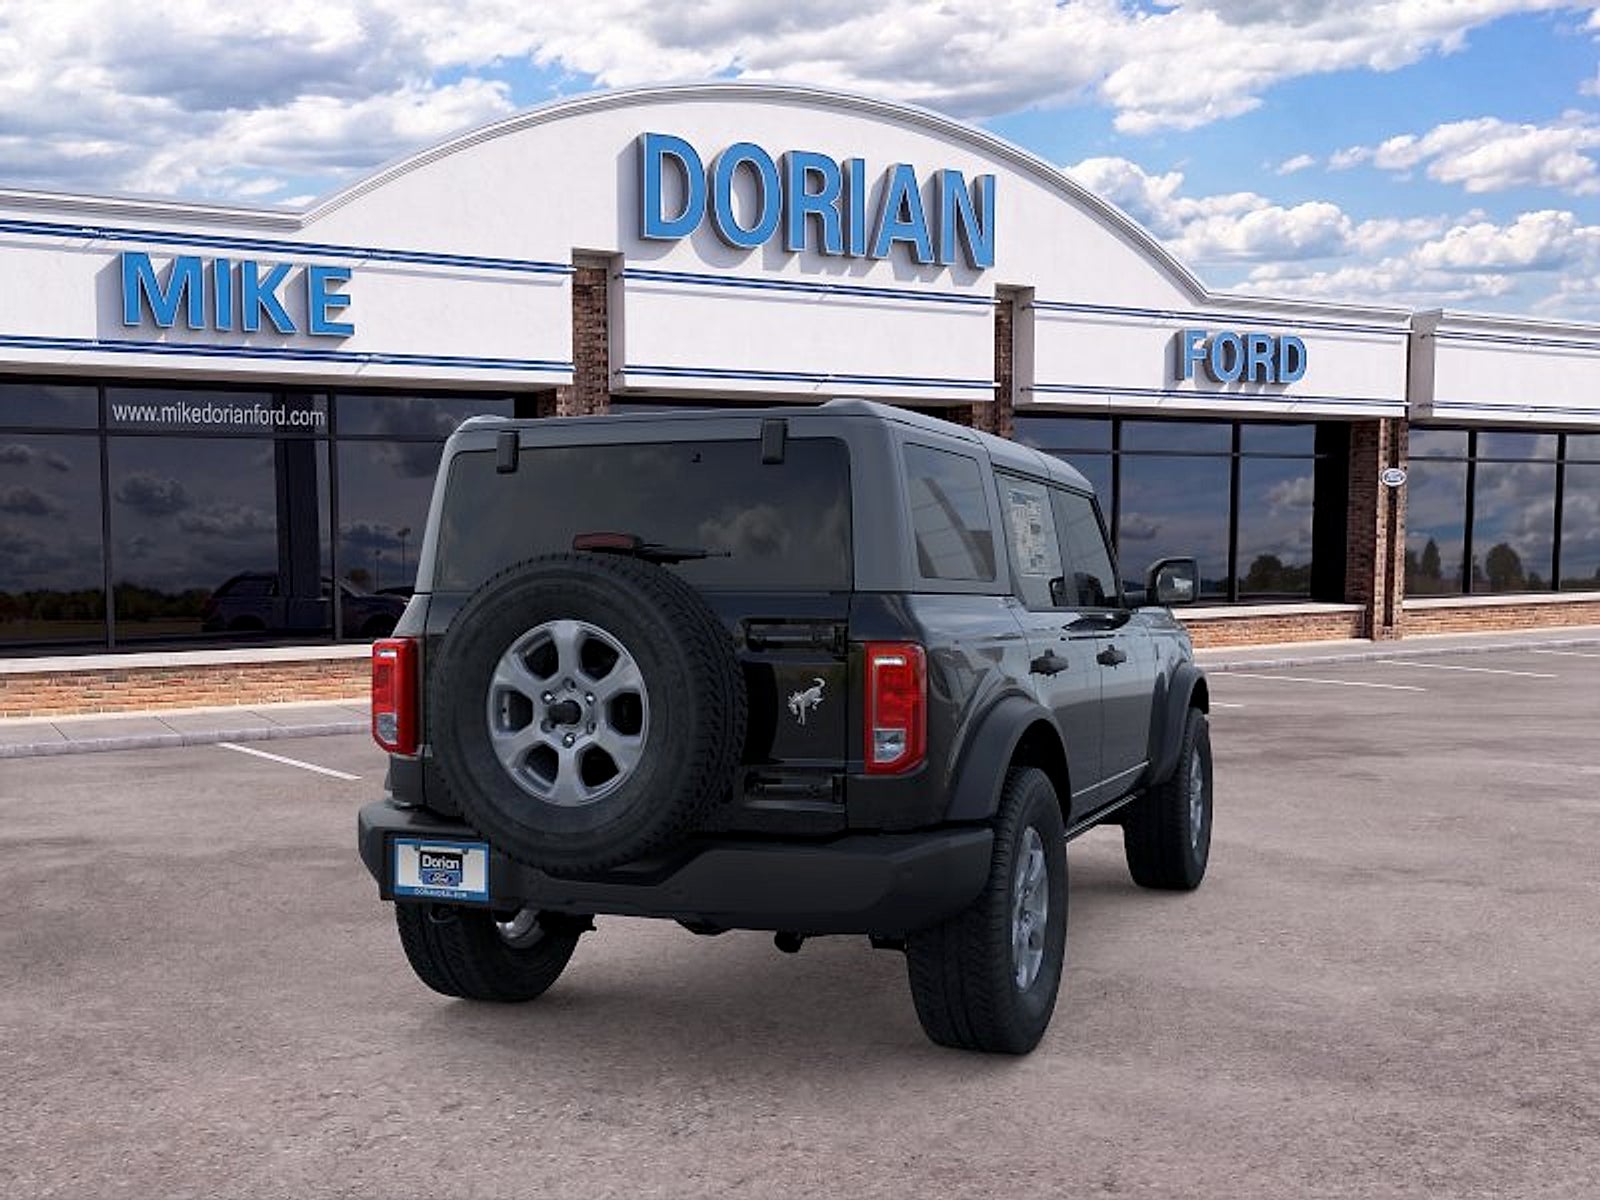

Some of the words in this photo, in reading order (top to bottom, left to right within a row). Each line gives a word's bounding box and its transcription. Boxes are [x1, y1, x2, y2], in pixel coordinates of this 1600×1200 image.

[640, 132, 995, 269] DORIAN
[121, 251, 354, 337] MIKE
[1179, 327, 1308, 384] FORD
[112, 401, 325, 427] www.mikedorianford.com
[422, 854, 459, 869] Dorian
